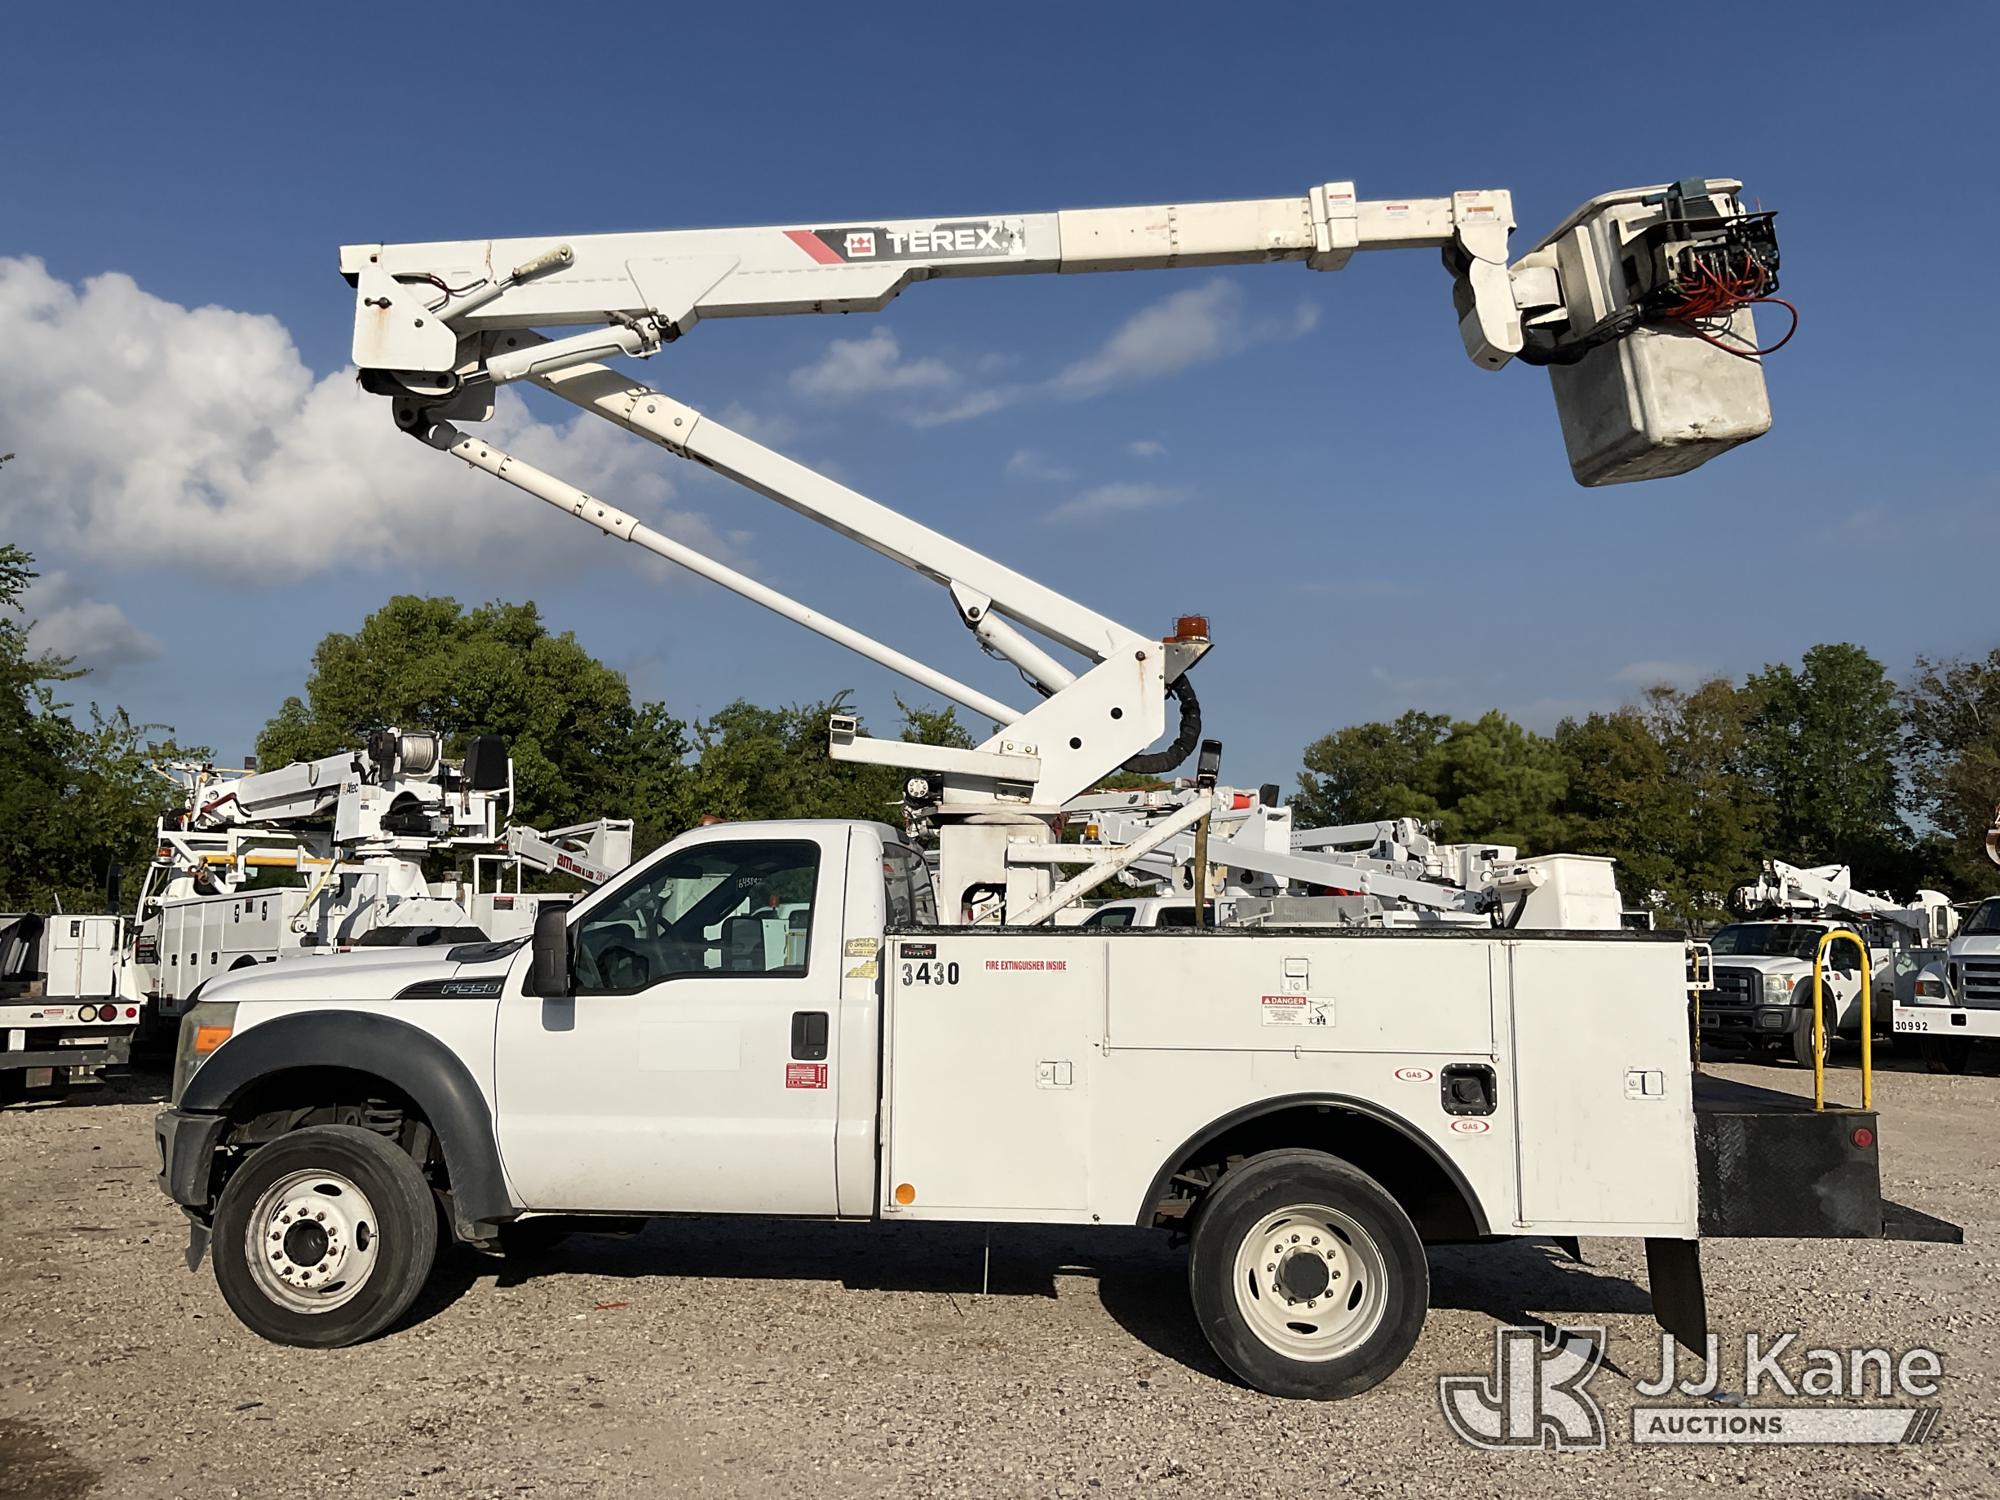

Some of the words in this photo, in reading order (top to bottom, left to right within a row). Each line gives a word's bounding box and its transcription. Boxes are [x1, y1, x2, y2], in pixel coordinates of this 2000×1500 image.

[985, 960, 1000, 971] FIRE
[1000, 960, 1045, 971] EXTINGUISHER
[1045, 960, 1067, 971] INSIDE
[902, 961, 960, 987] 3430
[1271, 997, 1305, 1005] DANGER
[1895, 1021, 1928, 1031] 30992
[1405, 1071, 1422, 1079] GAS
[1462, 1123, 1478, 1131] GAS
